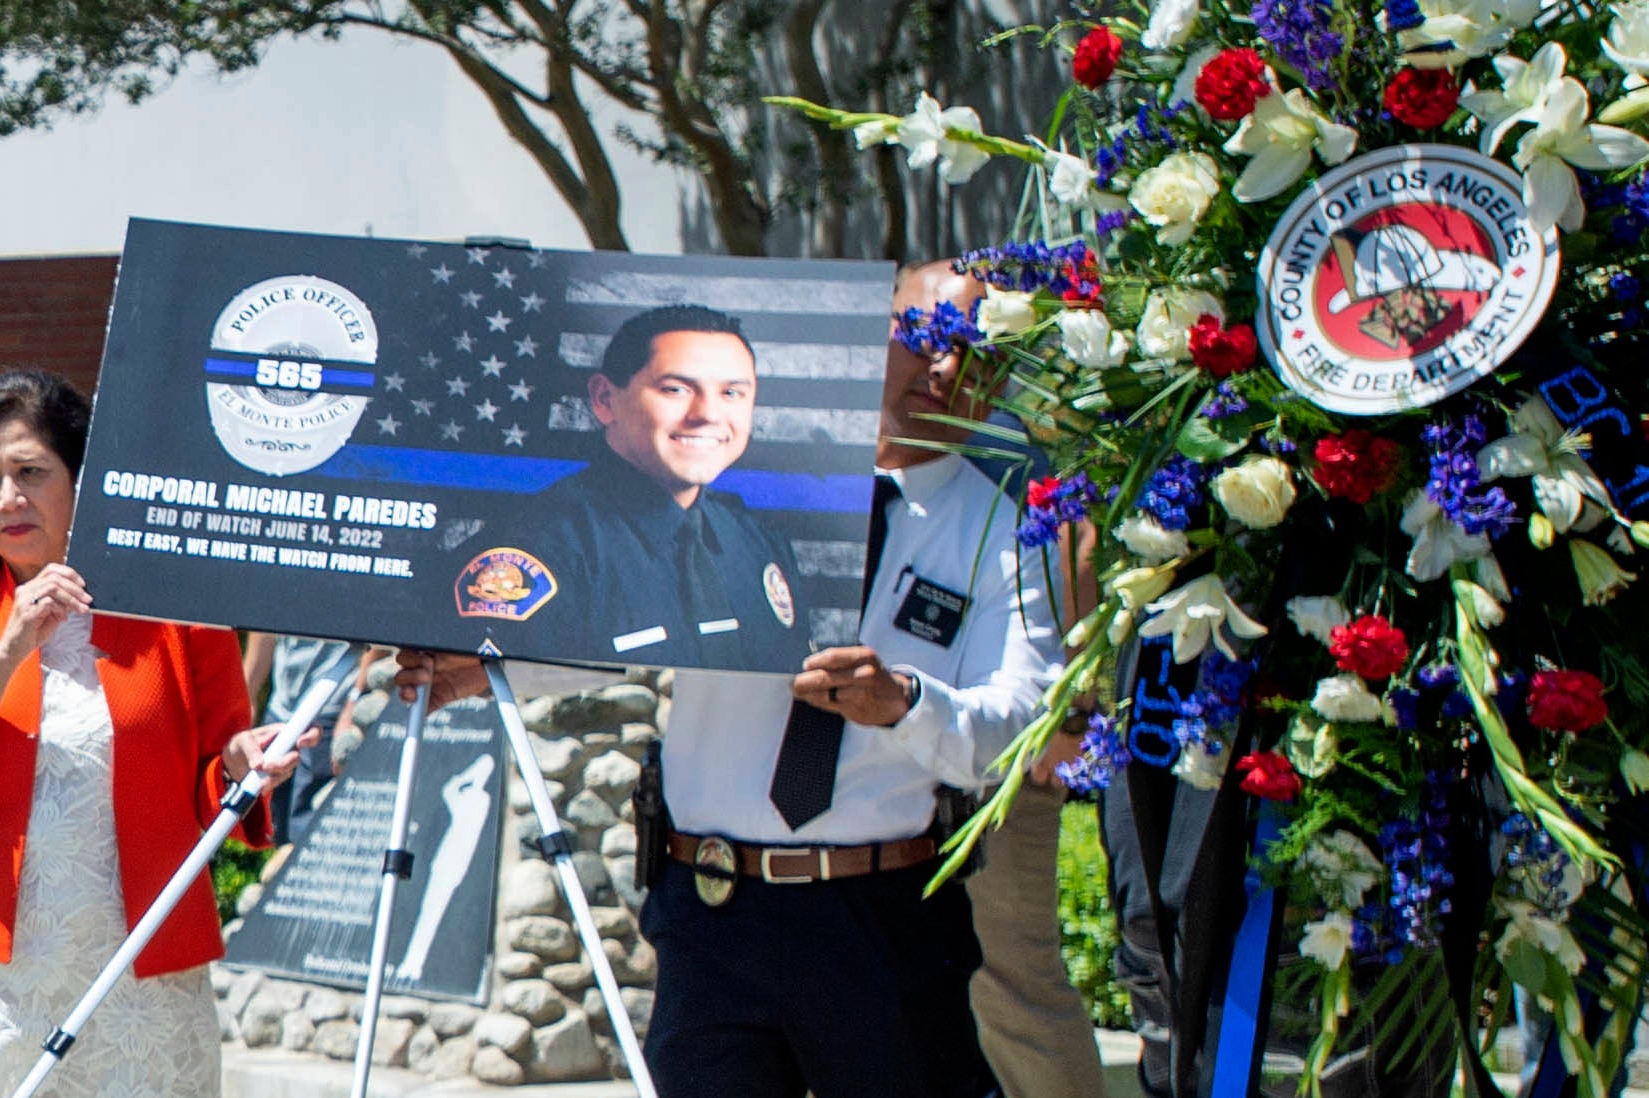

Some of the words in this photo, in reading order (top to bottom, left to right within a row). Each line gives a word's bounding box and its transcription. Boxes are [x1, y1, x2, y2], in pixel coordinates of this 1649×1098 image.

[1280, 220, 1326, 322] COUNTY
[1325, 187, 1362, 220] OF
[1368, 170, 1428, 198] LOS
[1434, 170, 1530, 259] ANGELES
[231, 287, 296, 333] POLICE
[303, 287, 365, 343] OFFICER
[1297, 343, 1349, 386] FIRE
[1352, 287, 1524, 393] DEPARTMENT
[255, 358, 323, 390] 565
[218, 390, 233, 407] EL
[238, 405, 295, 430] MONTE
[299, 400, 354, 427] POLICE
[103, 470, 220, 507] CORPORAL
[225, 484, 327, 520] MICHAEL
[333, 495, 438, 529] PAREDES
[107, 527, 142, 548] REST
[143, 531, 182, 555] EASY,
[186, 536, 209, 556] WE
[210, 539, 247, 561] HAVE
[249, 543, 276, 563] THE
[278, 546, 327, 569] WATCH
[330, 552, 371, 574] FROM
[373, 557, 414, 577] HERE.
[146, 505, 178, 527] END
[181, 508, 203, 529] OF
[206, 511, 262, 537] WATCH
[265, 519, 307, 542] JUNE
[311, 523, 334, 546] 14,
[339, 527, 383, 549] 2022
